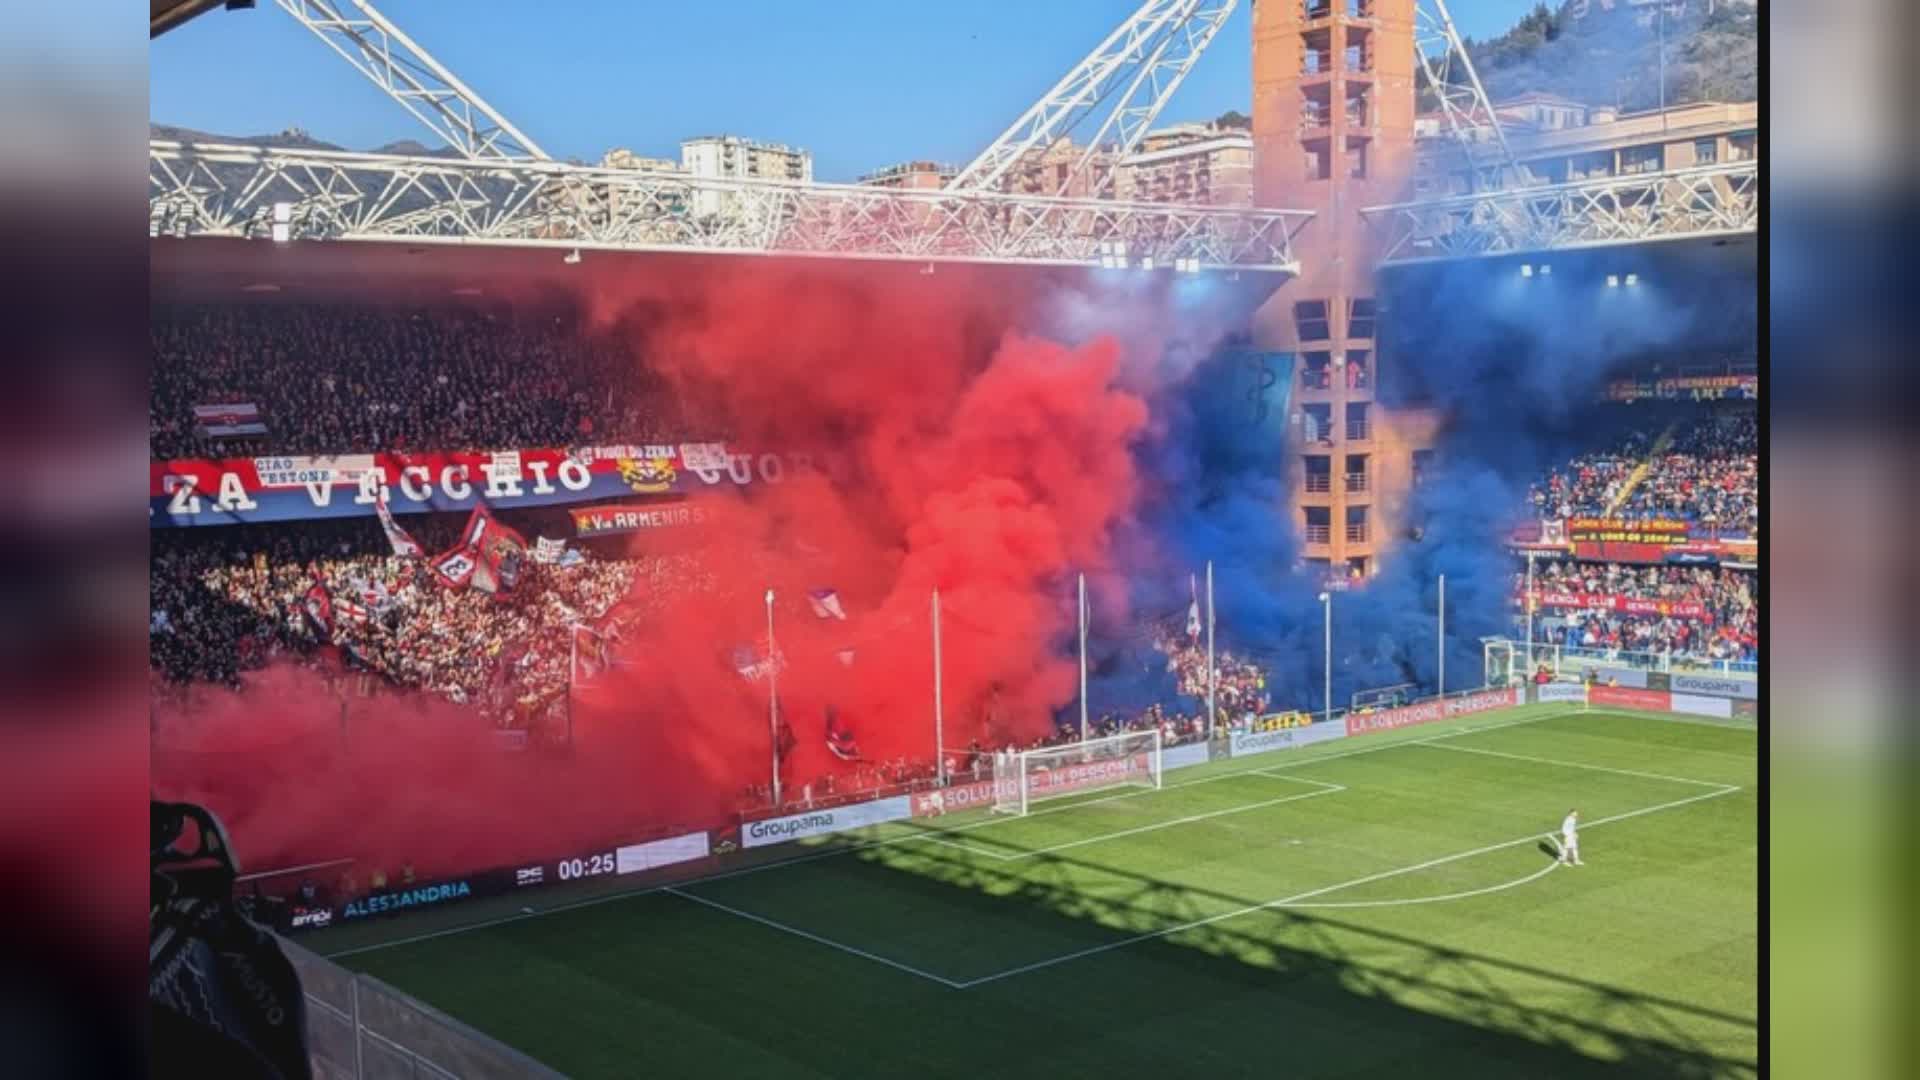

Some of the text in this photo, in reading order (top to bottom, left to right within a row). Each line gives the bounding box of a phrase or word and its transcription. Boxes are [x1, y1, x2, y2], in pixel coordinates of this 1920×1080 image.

[256, 459, 293, 471] CIAO
[303, 459, 592, 506] VECCHIO
[1672, 603, 1699, 616] CLUB
[1675, 678, 1742, 695] Groupama
[1350, 715, 1367, 732] LA
[1369, 706, 1441, 729] SOLUZIONE
[749, 811, 834, 840] Groupama
[558, 852, 615, 881] 00:25
[343, 881, 470, 918] ALESSANDRIA
